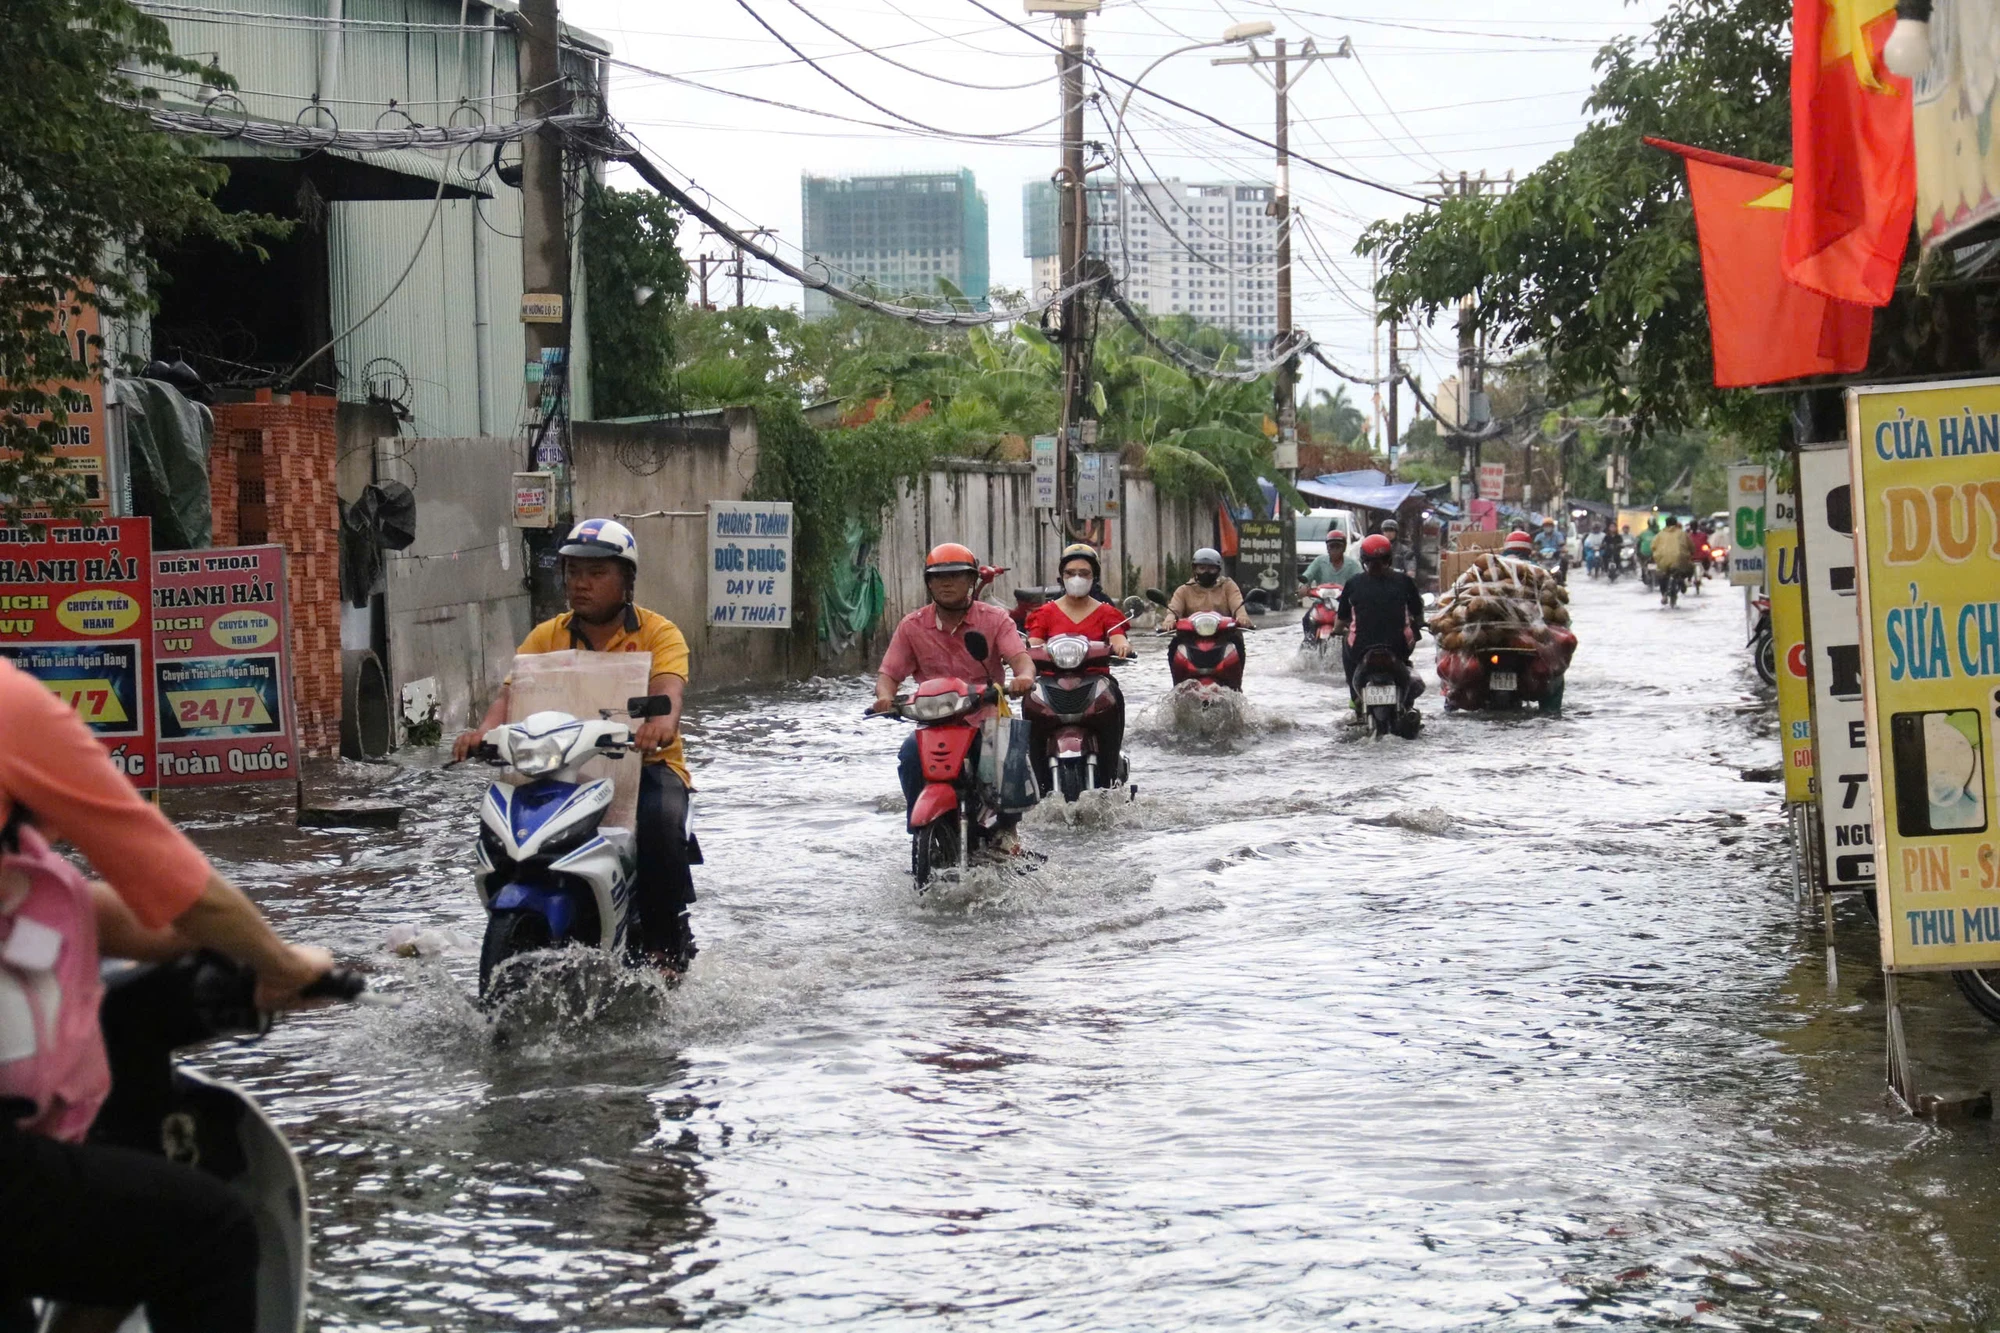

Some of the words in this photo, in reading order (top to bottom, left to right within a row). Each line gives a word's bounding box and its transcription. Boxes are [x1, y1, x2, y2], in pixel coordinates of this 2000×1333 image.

[1876, 408, 1932, 460] CỬA
[1939, 407, 1999, 456] HÀN
[52, 526, 119, 545] THOẠI
[717, 507, 752, 535] PHÒNG
[755, 512, 789, 536] TRANH
[84, 548, 137, 581] HẢI
[159, 557, 200, 575] ĐIỆN
[205, 555, 259, 572] THOẠI
[231, 574, 274, 604] HẢI
[726, 579, 755, 598] DẠY
[758, 576, 775, 595] VẼ
[83, 618, 114, 629] NHANH
[714, 602, 736, 622] MỸ
[741, 603, 787, 625] THUẬT
[1887, 582, 1951, 680] SỬA
[104, 652, 127, 668] Hàng
[162, 638, 193, 654] VỤ
[249, 663, 270, 678] Hàng
[179, 696, 256, 725] 24/7
[157, 750, 221, 776] Toàn
[227, 743, 289, 774] Quốc
[1902, 847, 1951, 892] PIN
[1978, 843, 2000, 888] S
[1906, 909, 1955, 945] THU
